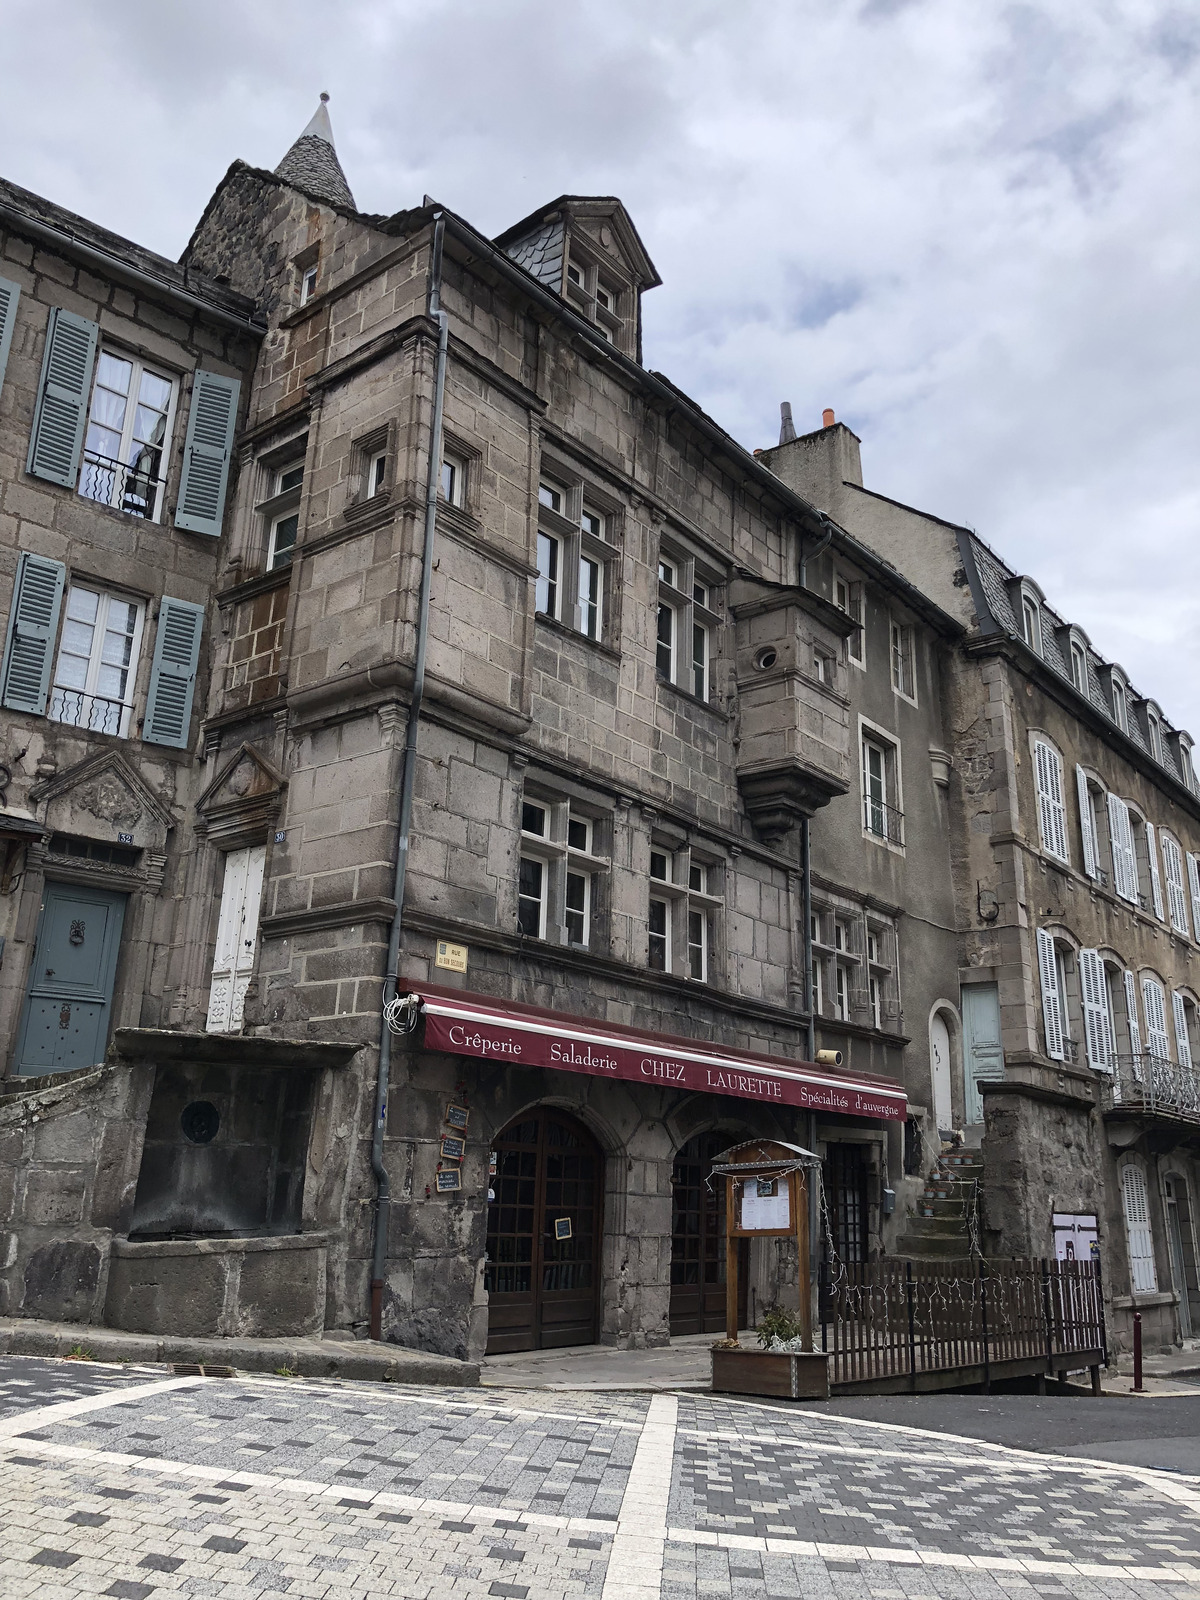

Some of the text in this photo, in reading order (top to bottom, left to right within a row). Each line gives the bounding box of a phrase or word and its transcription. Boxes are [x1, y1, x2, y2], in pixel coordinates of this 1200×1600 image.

[120, 834, 132, 844] 32
[451, 949, 461, 957] RUE
[449, 1025, 899, 1116] Crêperie Saladerie CHEZ LAURETTE Spécialités d'auvergne
